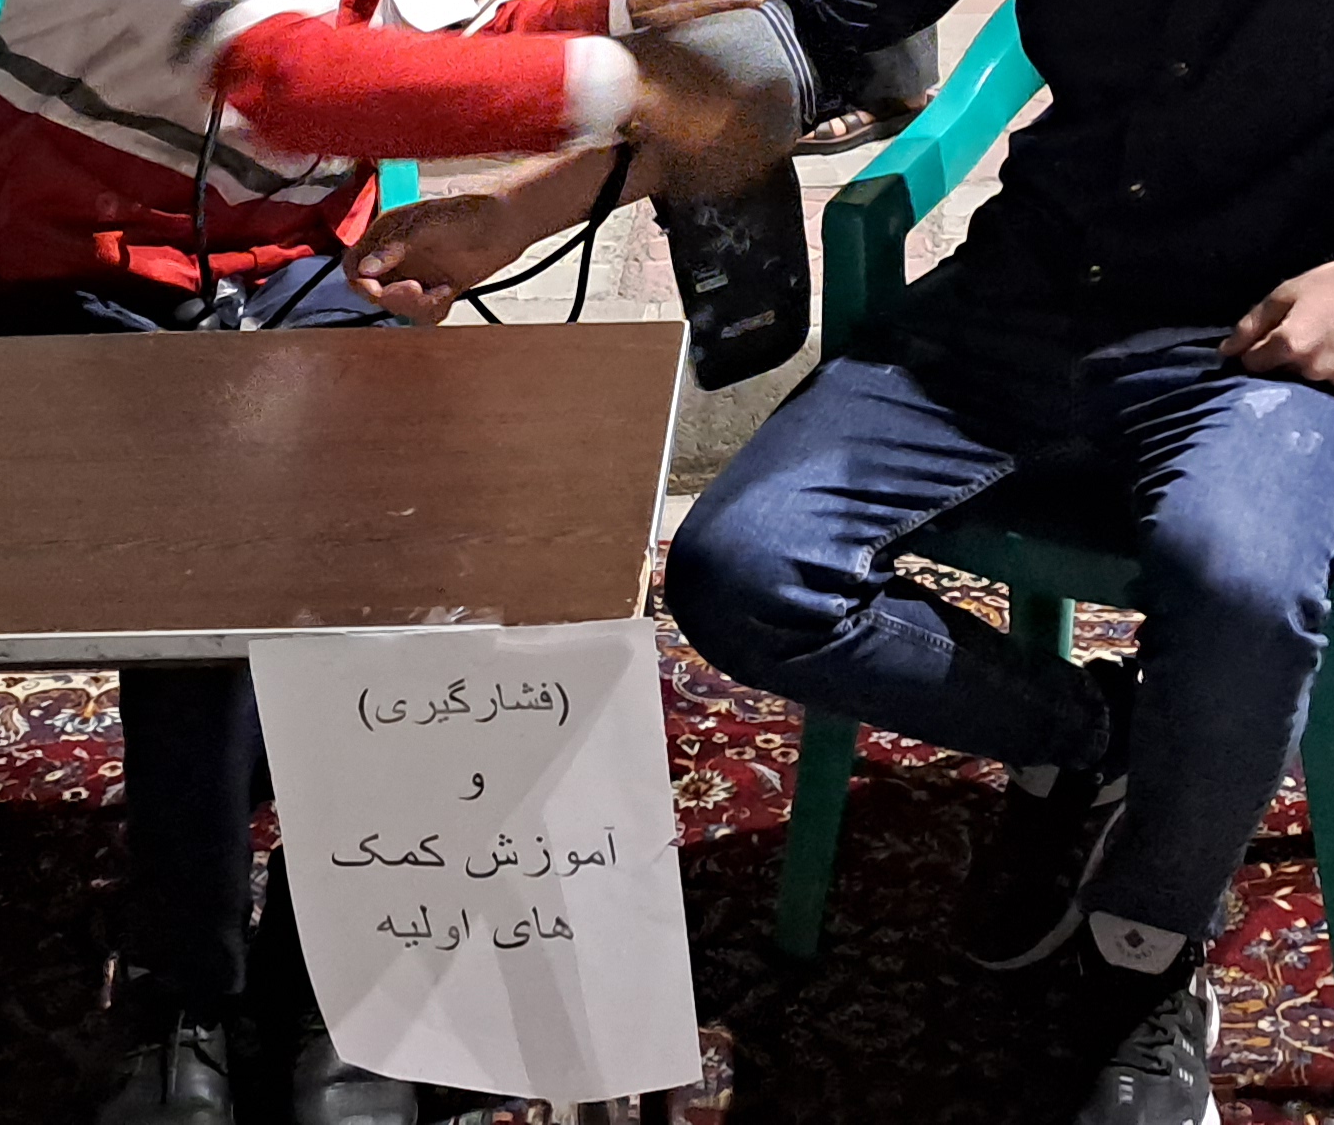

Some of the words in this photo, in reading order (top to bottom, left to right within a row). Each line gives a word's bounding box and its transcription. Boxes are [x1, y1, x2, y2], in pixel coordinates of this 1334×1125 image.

[357, 677, 571, 733] (فشارگیری)
[458, 771, 487, 801] و
[330, 832, 447, 868] کمک
[464, 825, 618, 880] آموزش
[375, 903, 471, 952] اولیه
[491, 905, 576, 951] های
